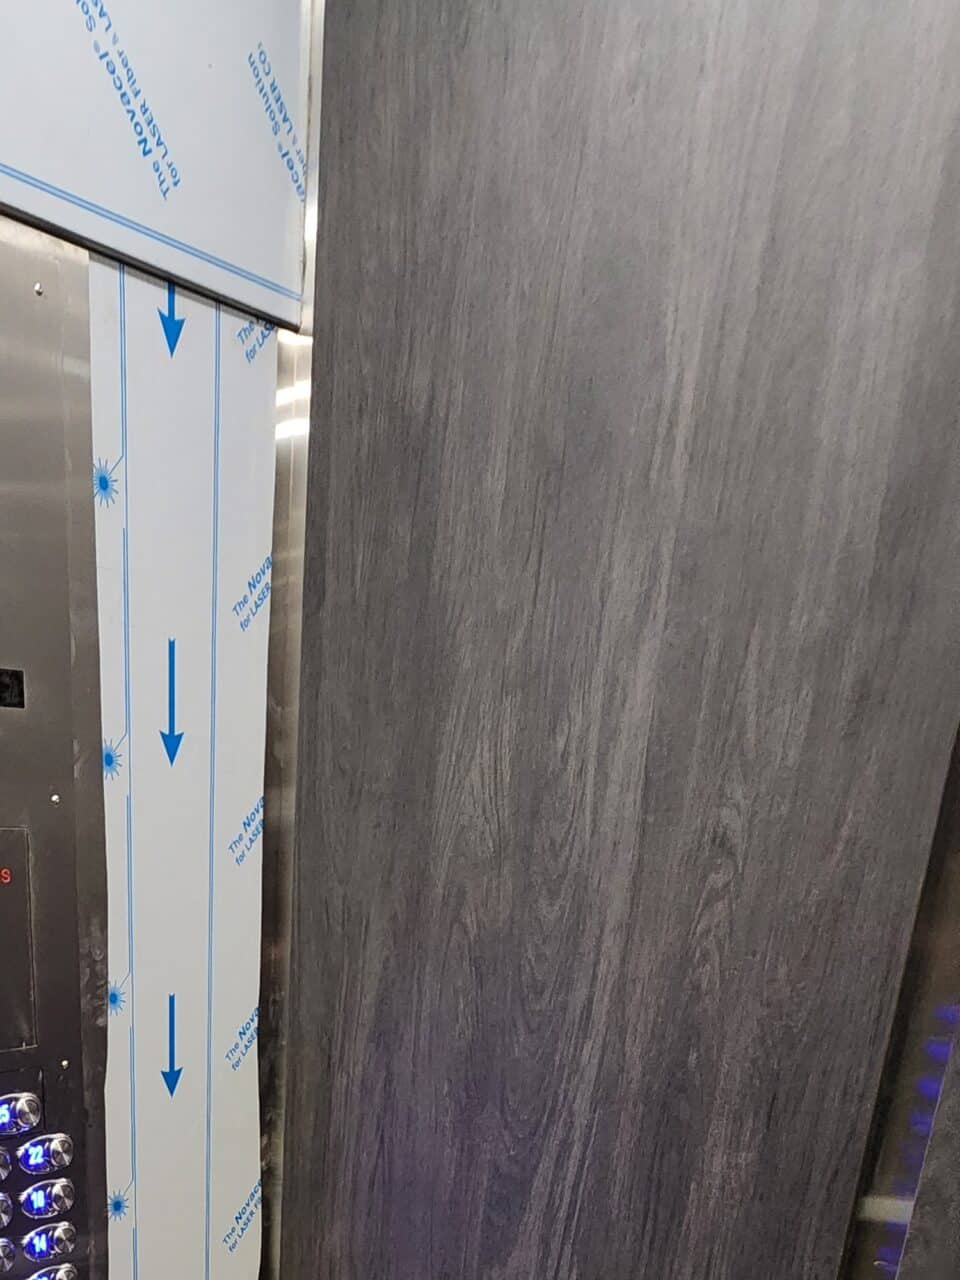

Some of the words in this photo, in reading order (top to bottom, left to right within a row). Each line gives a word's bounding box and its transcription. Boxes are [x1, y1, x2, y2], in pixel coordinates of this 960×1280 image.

[117, 50, 141, 98] Fiber
[248, 53, 280, 136] Solution
[270, 77, 293, 135] LASER
[140, 98, 168, 160] LASER
[152, 160, 170, 200] The
[167, 160, 181, 187] for
[232, 594, 249, 616] The
[228, 833, 243, 854] The
[225, 1042, 239, 1061] The
[28, 1145, 44, 1164] 22
[32, 1235, 47, 1253] 14
